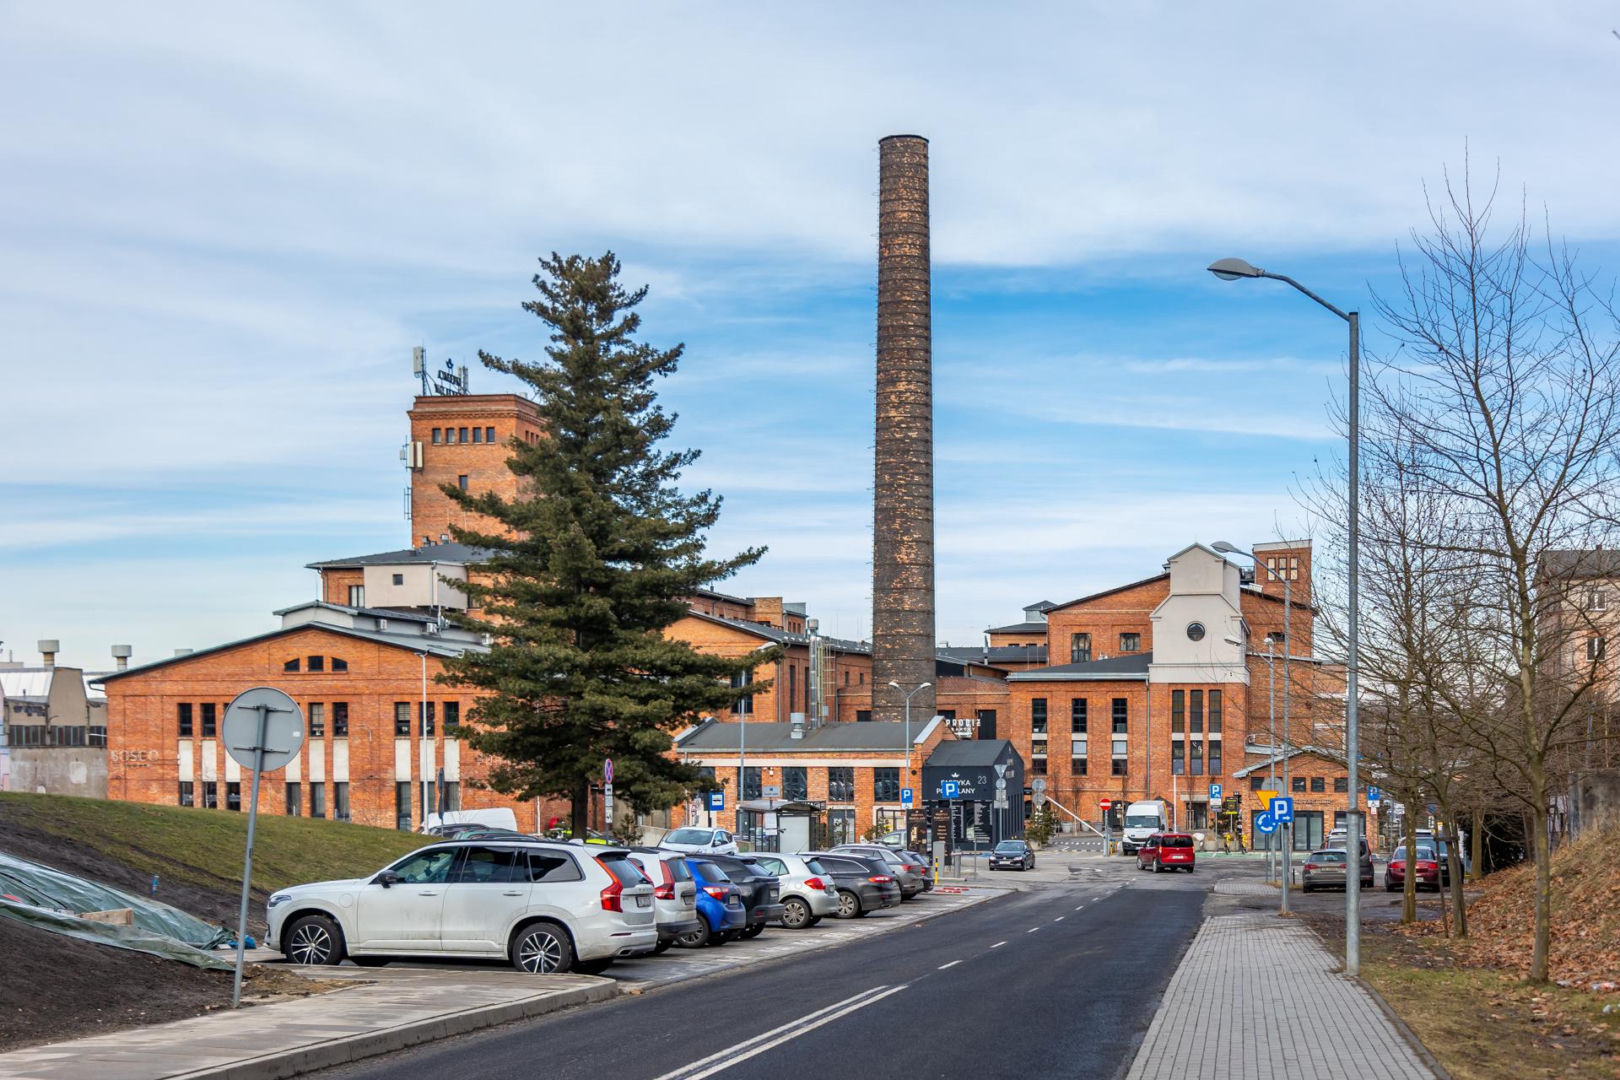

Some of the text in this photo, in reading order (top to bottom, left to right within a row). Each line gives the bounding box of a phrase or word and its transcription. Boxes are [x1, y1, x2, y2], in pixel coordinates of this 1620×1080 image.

[977, 775, 987, 785] 23
[903, 789, 911, 798] P
[945, 783, 955, 796] P
[1274, 800, 1288, 820] P
